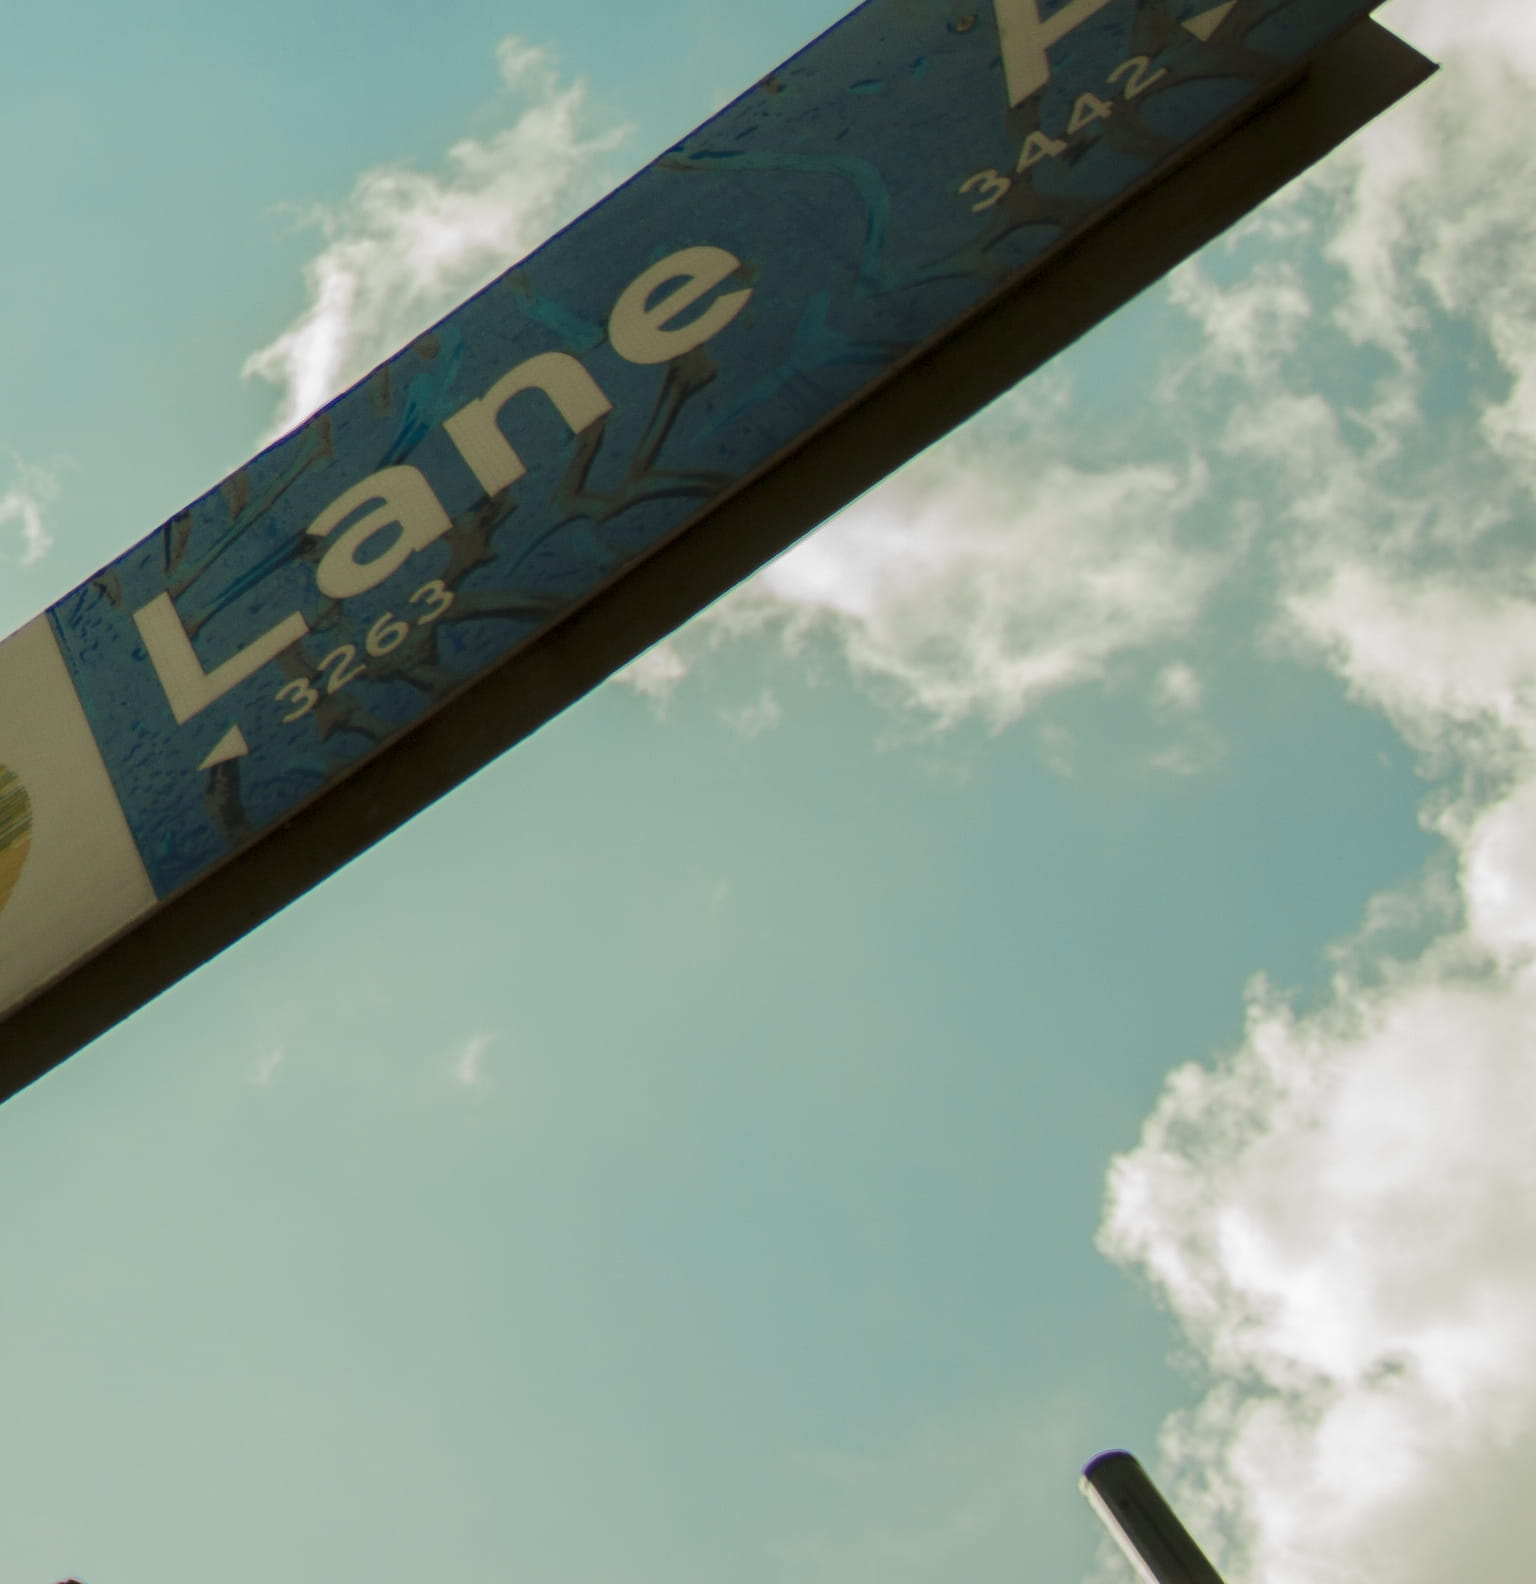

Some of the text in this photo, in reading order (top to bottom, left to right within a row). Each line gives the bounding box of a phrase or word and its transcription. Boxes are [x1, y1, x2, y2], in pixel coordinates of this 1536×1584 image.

[958, 55, 1168, 214] 3442
[132, 245, 754, 726] Lane
[274, 578, 457, 725] 3263
